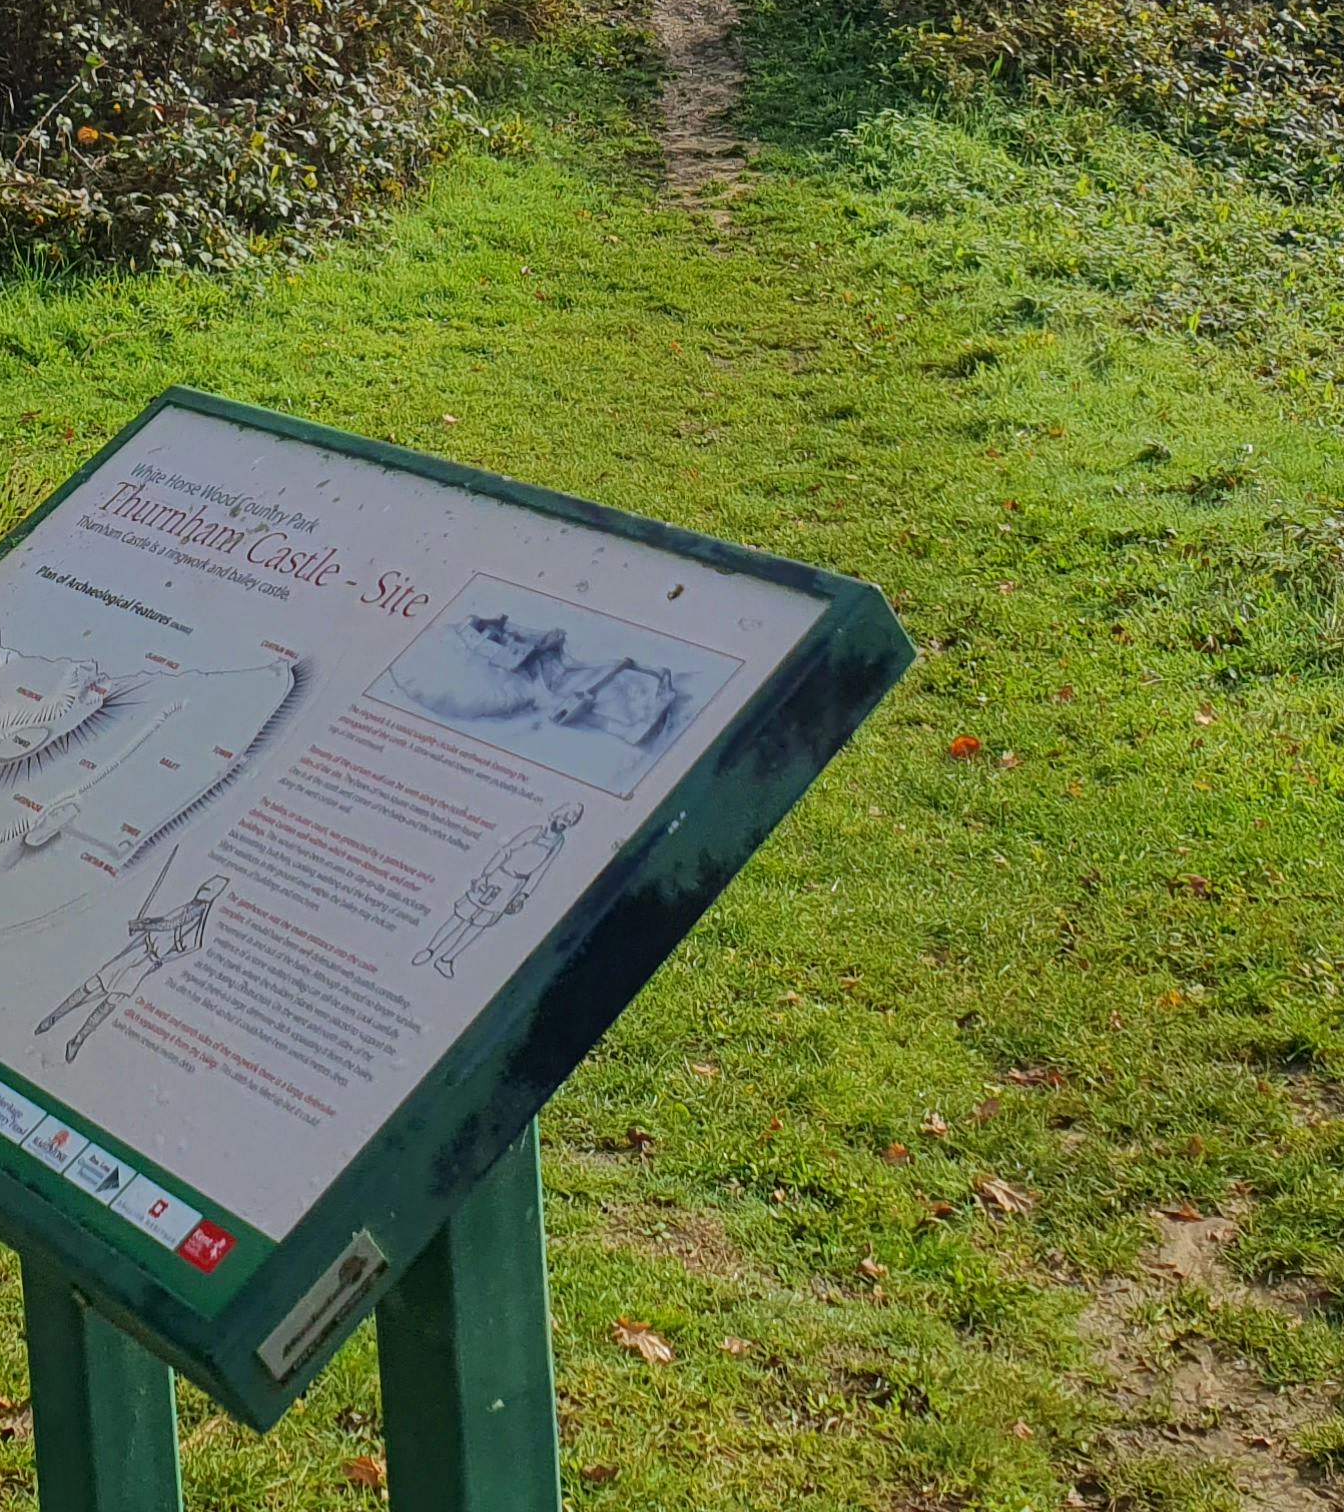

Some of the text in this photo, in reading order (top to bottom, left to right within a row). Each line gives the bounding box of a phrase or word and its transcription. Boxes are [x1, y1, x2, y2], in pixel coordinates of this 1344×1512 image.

[132, 464, 318, 533] White Horse Wood Country Park
[78, 516, 289, 600] Thurnham Castle is a ringwork and bailey castle.
[99, 481, 246, 554] Thurnham
[248, 533, 339, 586] Castle
[362, 572, 428, 617] Site
[37, 566, 171, 624] Plan of Archaeological Features
